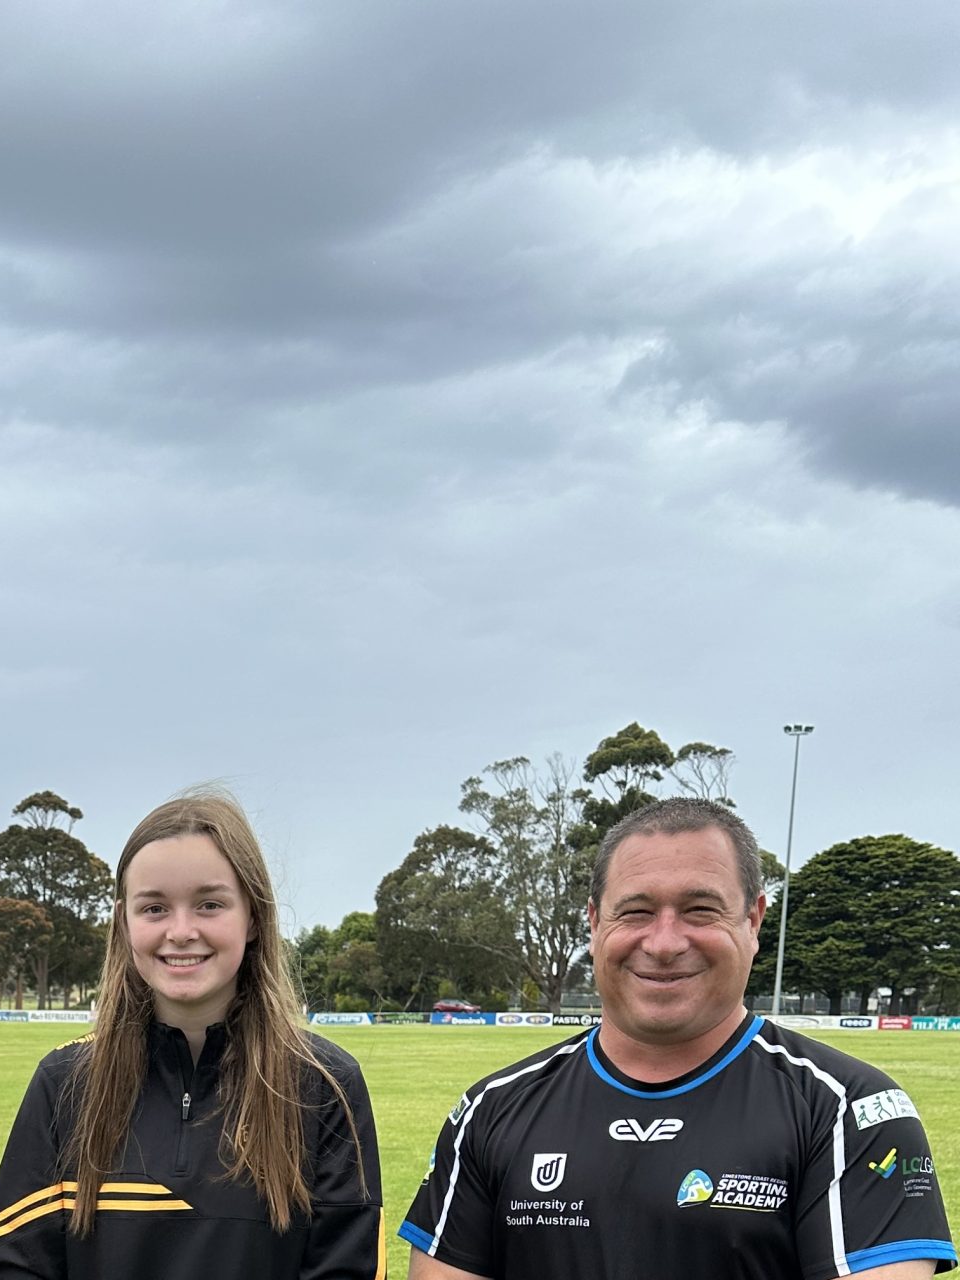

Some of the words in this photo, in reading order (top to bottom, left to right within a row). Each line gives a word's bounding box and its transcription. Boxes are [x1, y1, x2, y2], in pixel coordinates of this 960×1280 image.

[553, 1016, 580, 1025] FASTA
[842, 1019, 870, 1027] reece
[510, 1199, 567, 1213] University
[570, 1199, 585, 1211] of
[711, 1191, 787, 1209] ACADEMY
[506, 1214, 533, 1226] South
[535, 1214, 590, 1227] Australia
